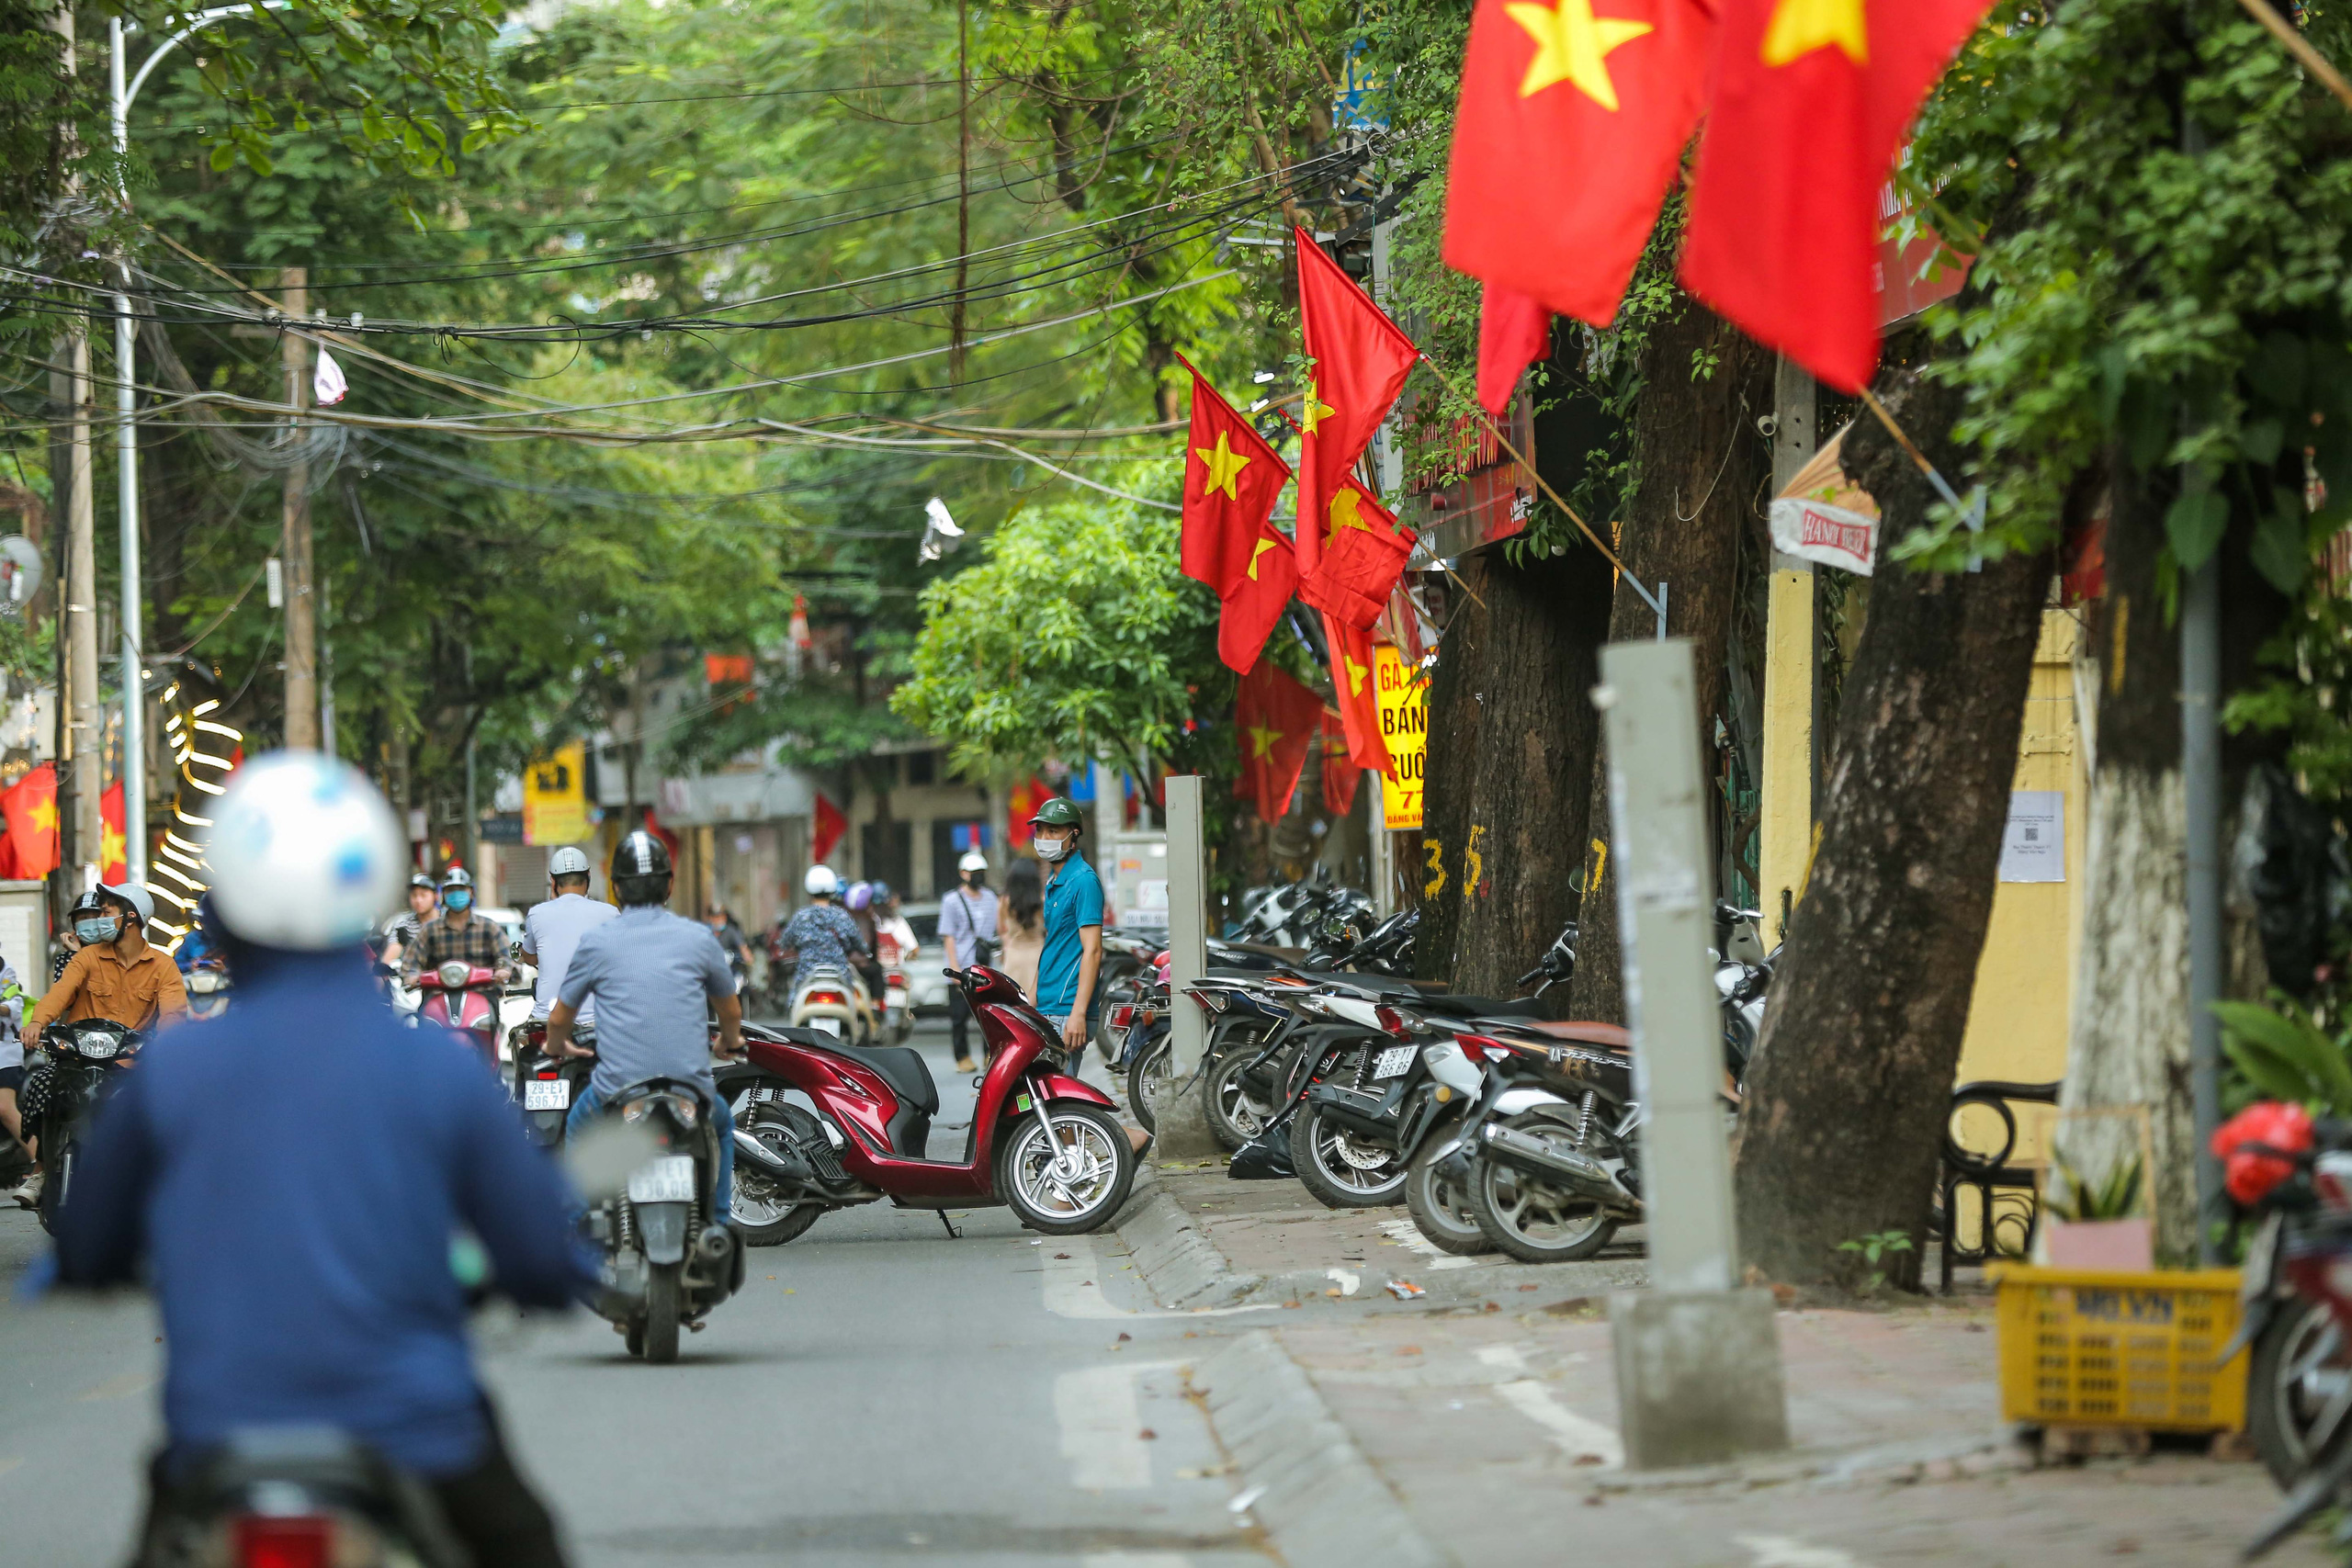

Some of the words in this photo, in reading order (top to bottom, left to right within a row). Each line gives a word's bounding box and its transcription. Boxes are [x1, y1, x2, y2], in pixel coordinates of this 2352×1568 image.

[1381, 658, 1403, 692] GÀ
[532, 1082, 562, 1094] 29-E1
[527, 1095, 566, 1108] 596.71
